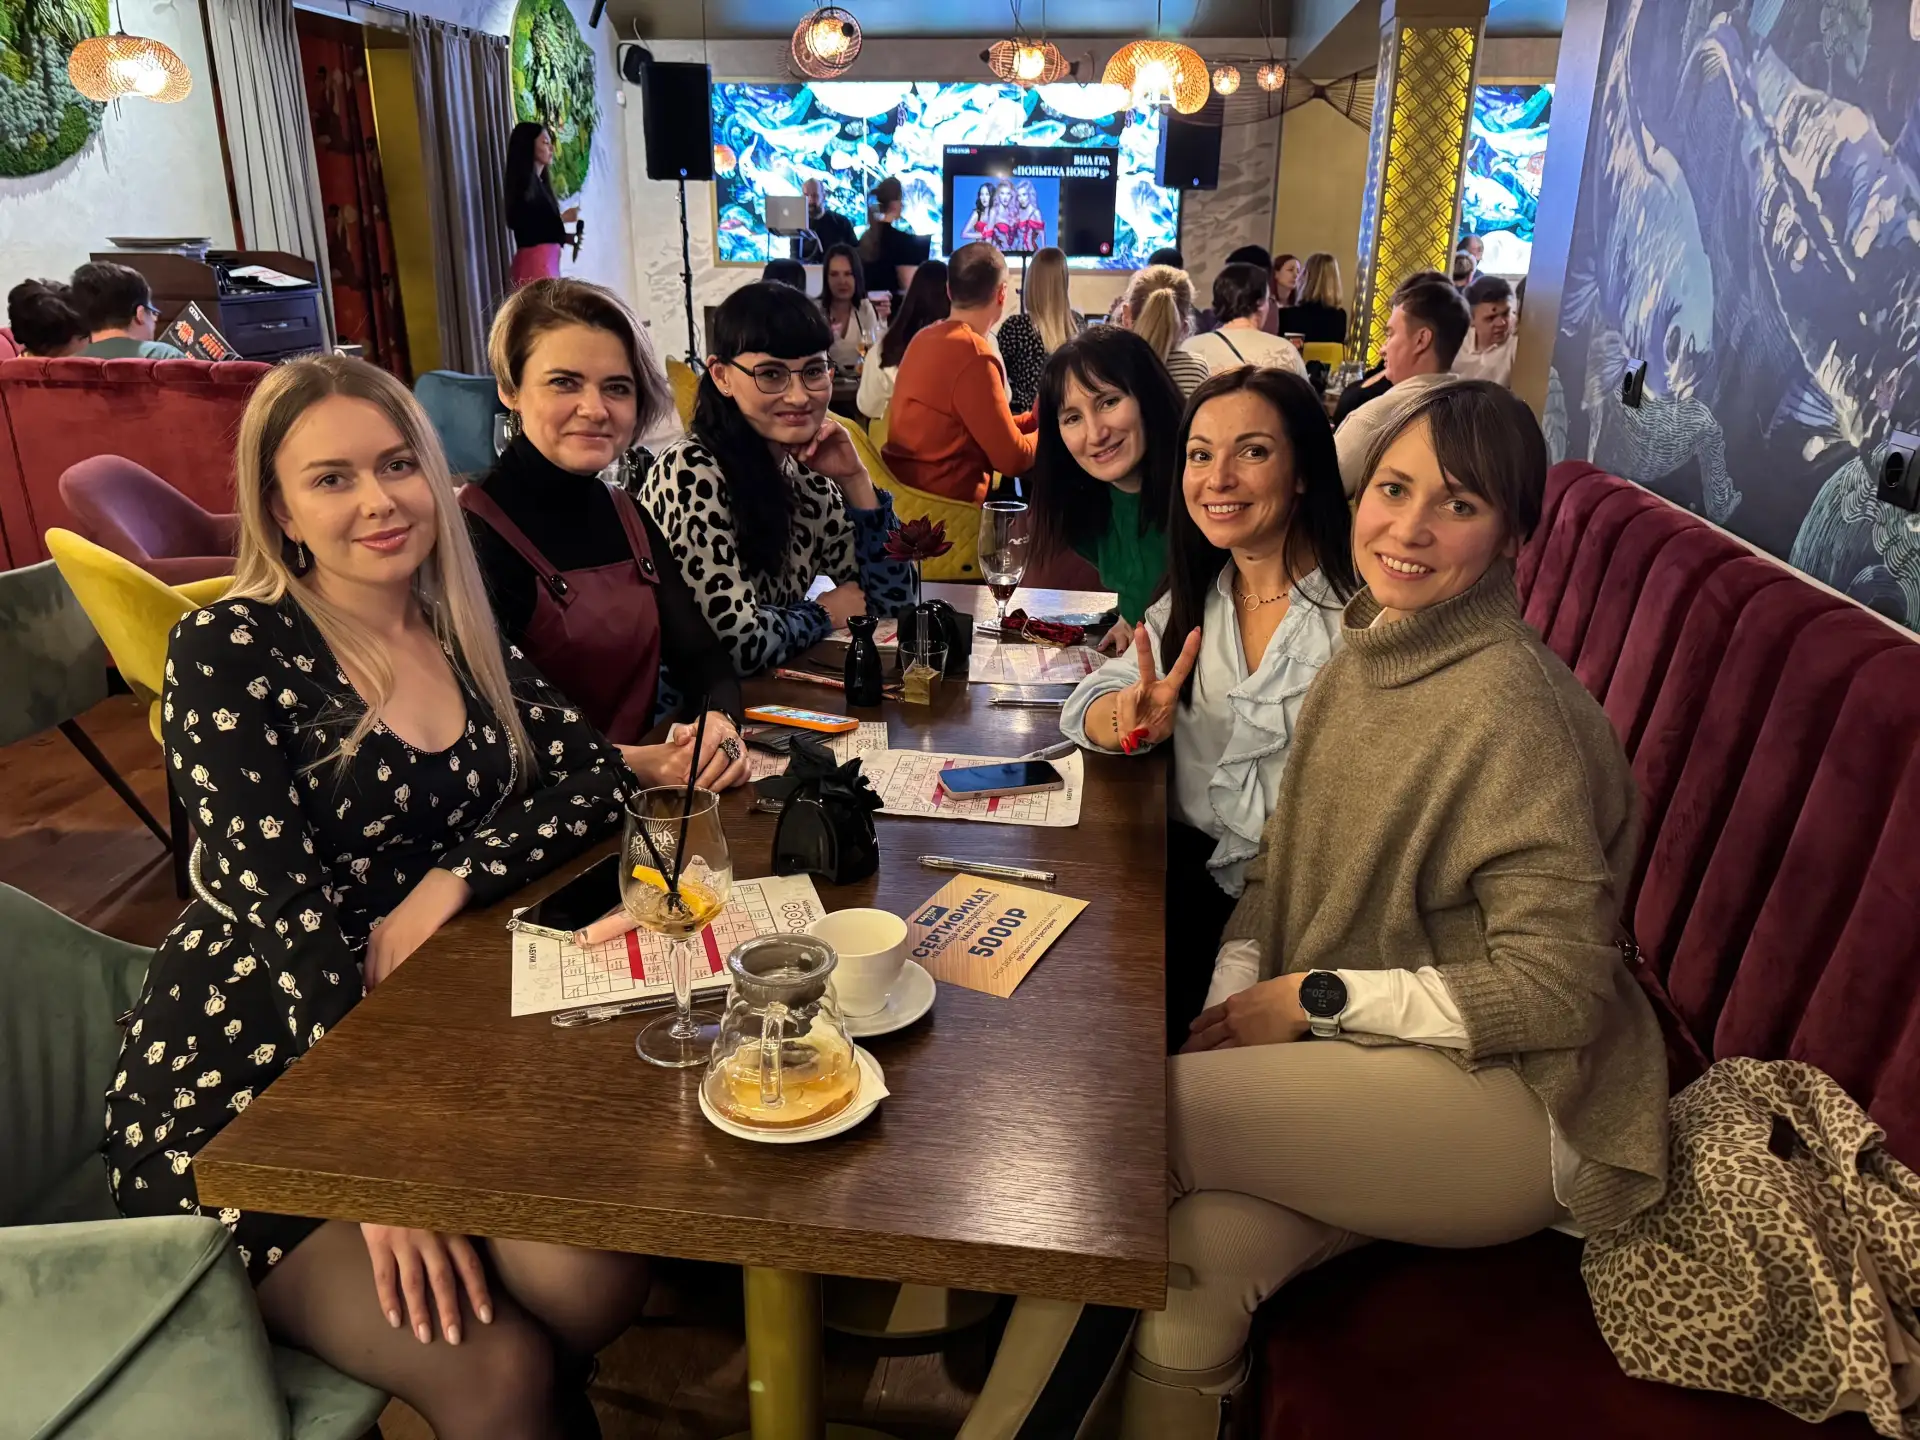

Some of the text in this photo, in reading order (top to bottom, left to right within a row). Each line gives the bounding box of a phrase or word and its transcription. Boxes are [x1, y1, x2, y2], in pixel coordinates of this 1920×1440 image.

[1093, 154, 1111, 166] ГРА
[1012, 165, 1066, 177] «ПОПЫТКА
[1065, 166, 1100, 178] НОМЕР
[911, 887, 992, 958] СЕРТИФИКАТ
[936, 932, 959, 951] блюда
[968, 907, 1029, 958] 5000Р
